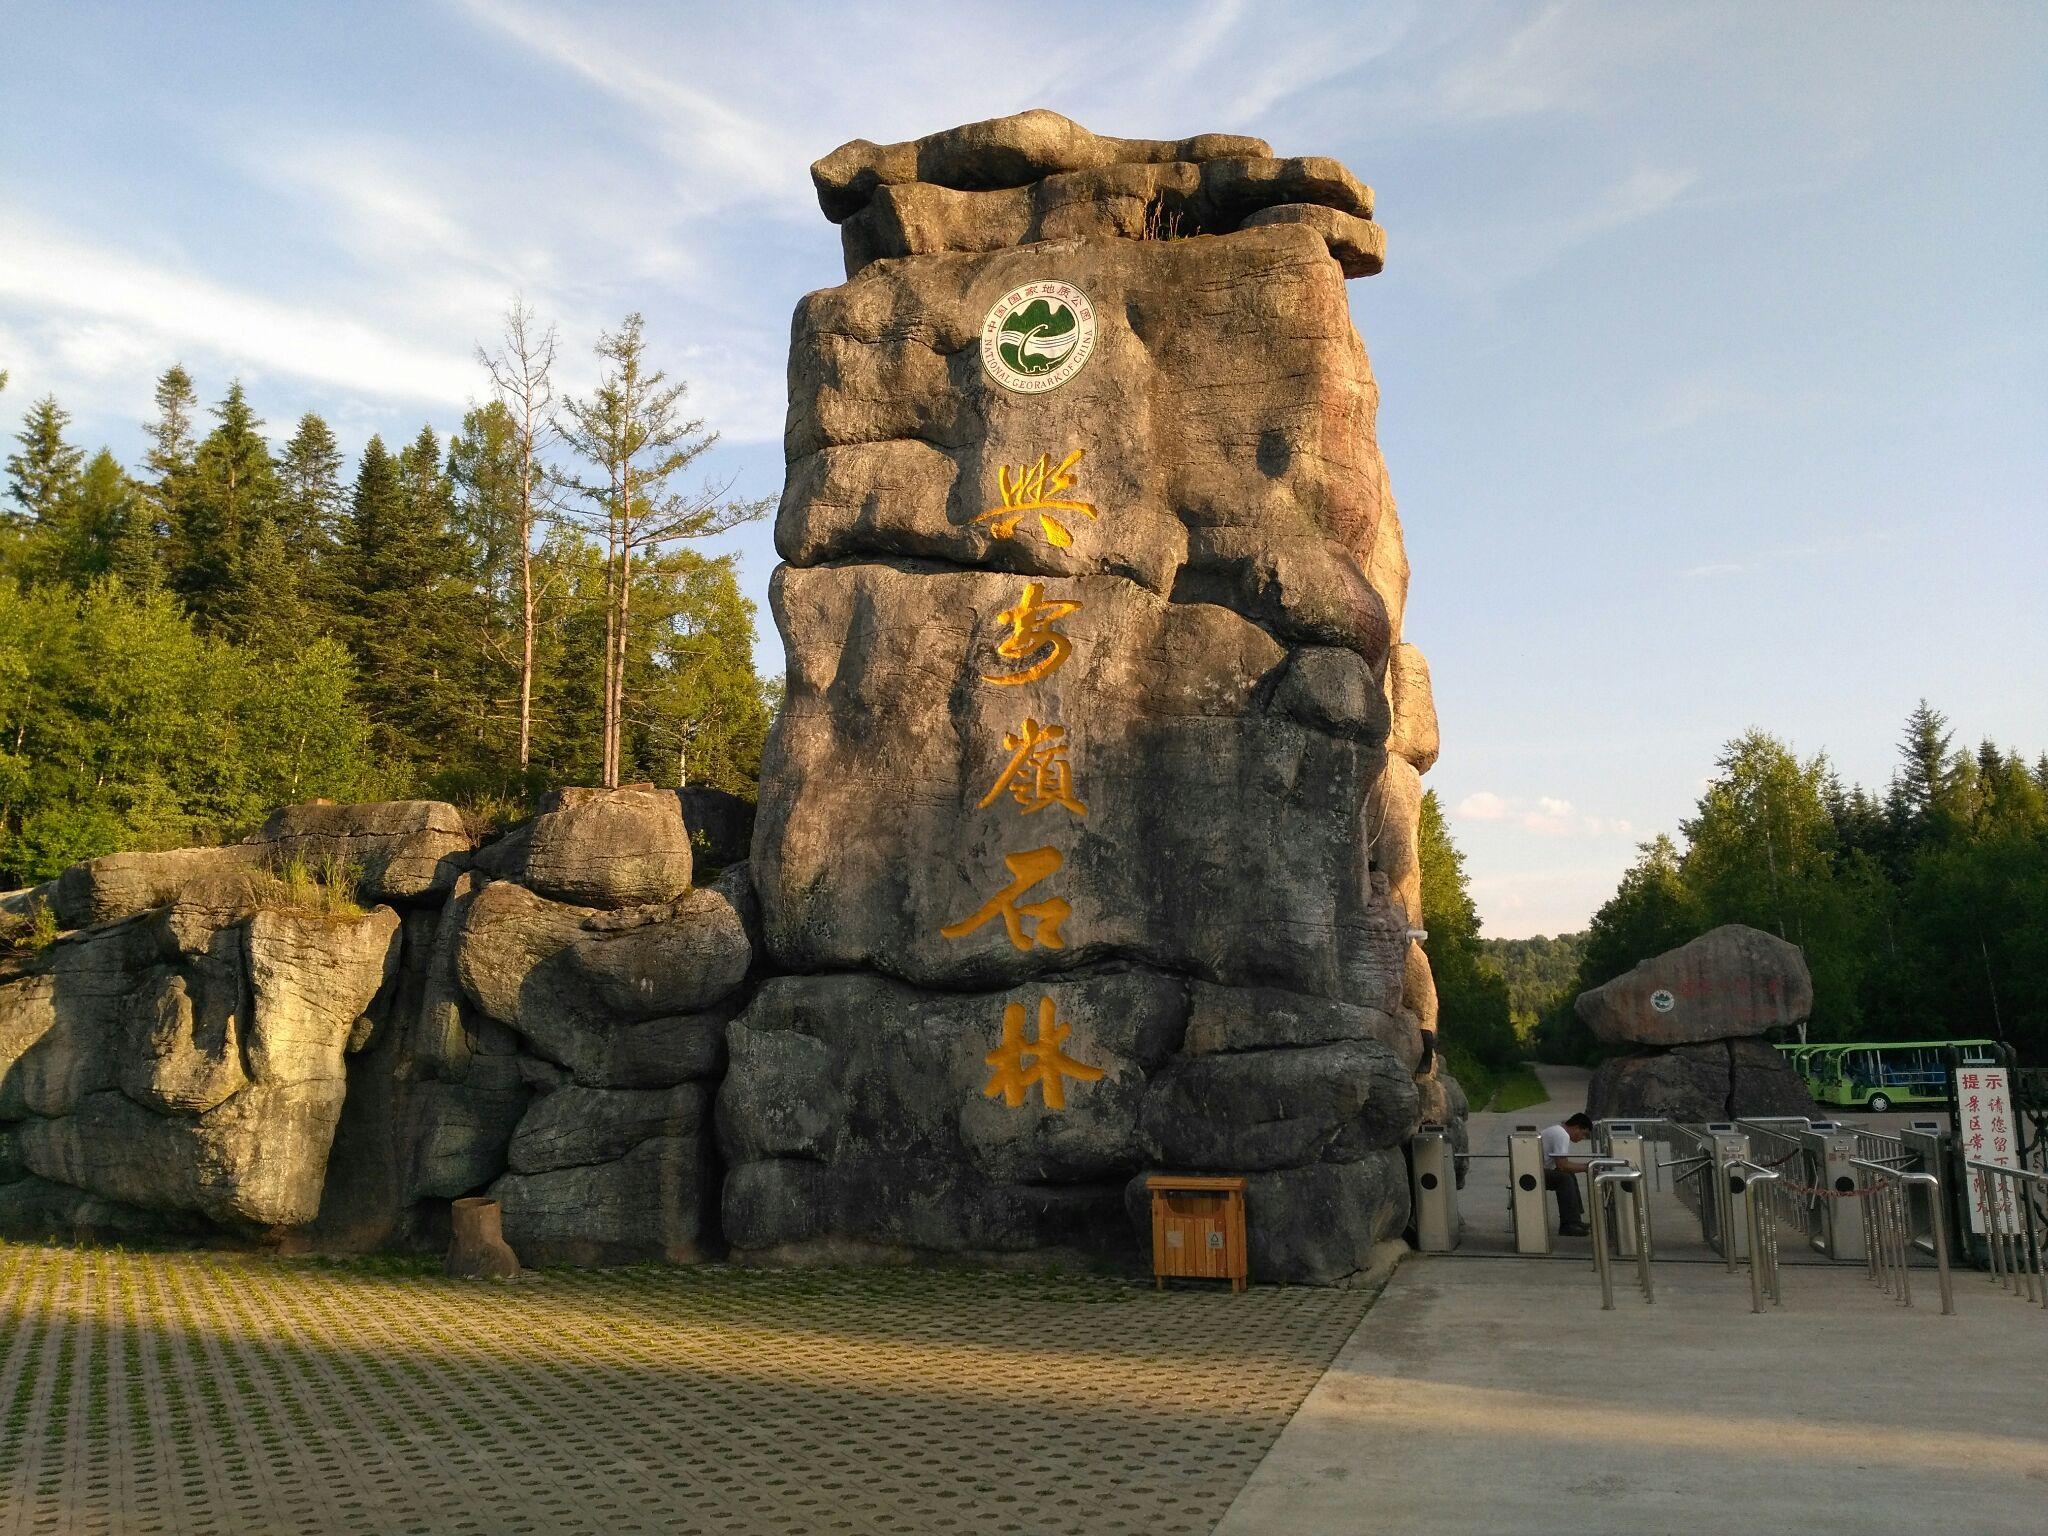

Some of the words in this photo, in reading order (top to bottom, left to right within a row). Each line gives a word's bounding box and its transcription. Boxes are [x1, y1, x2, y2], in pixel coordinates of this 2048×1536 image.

[984, 339, 1012, 384] NATIONAL
[1062, 364, 1076, 377] OF
[1073, 330, 1093, 363] CHINA
[1962, 1074, 2003, 1090] 提示
